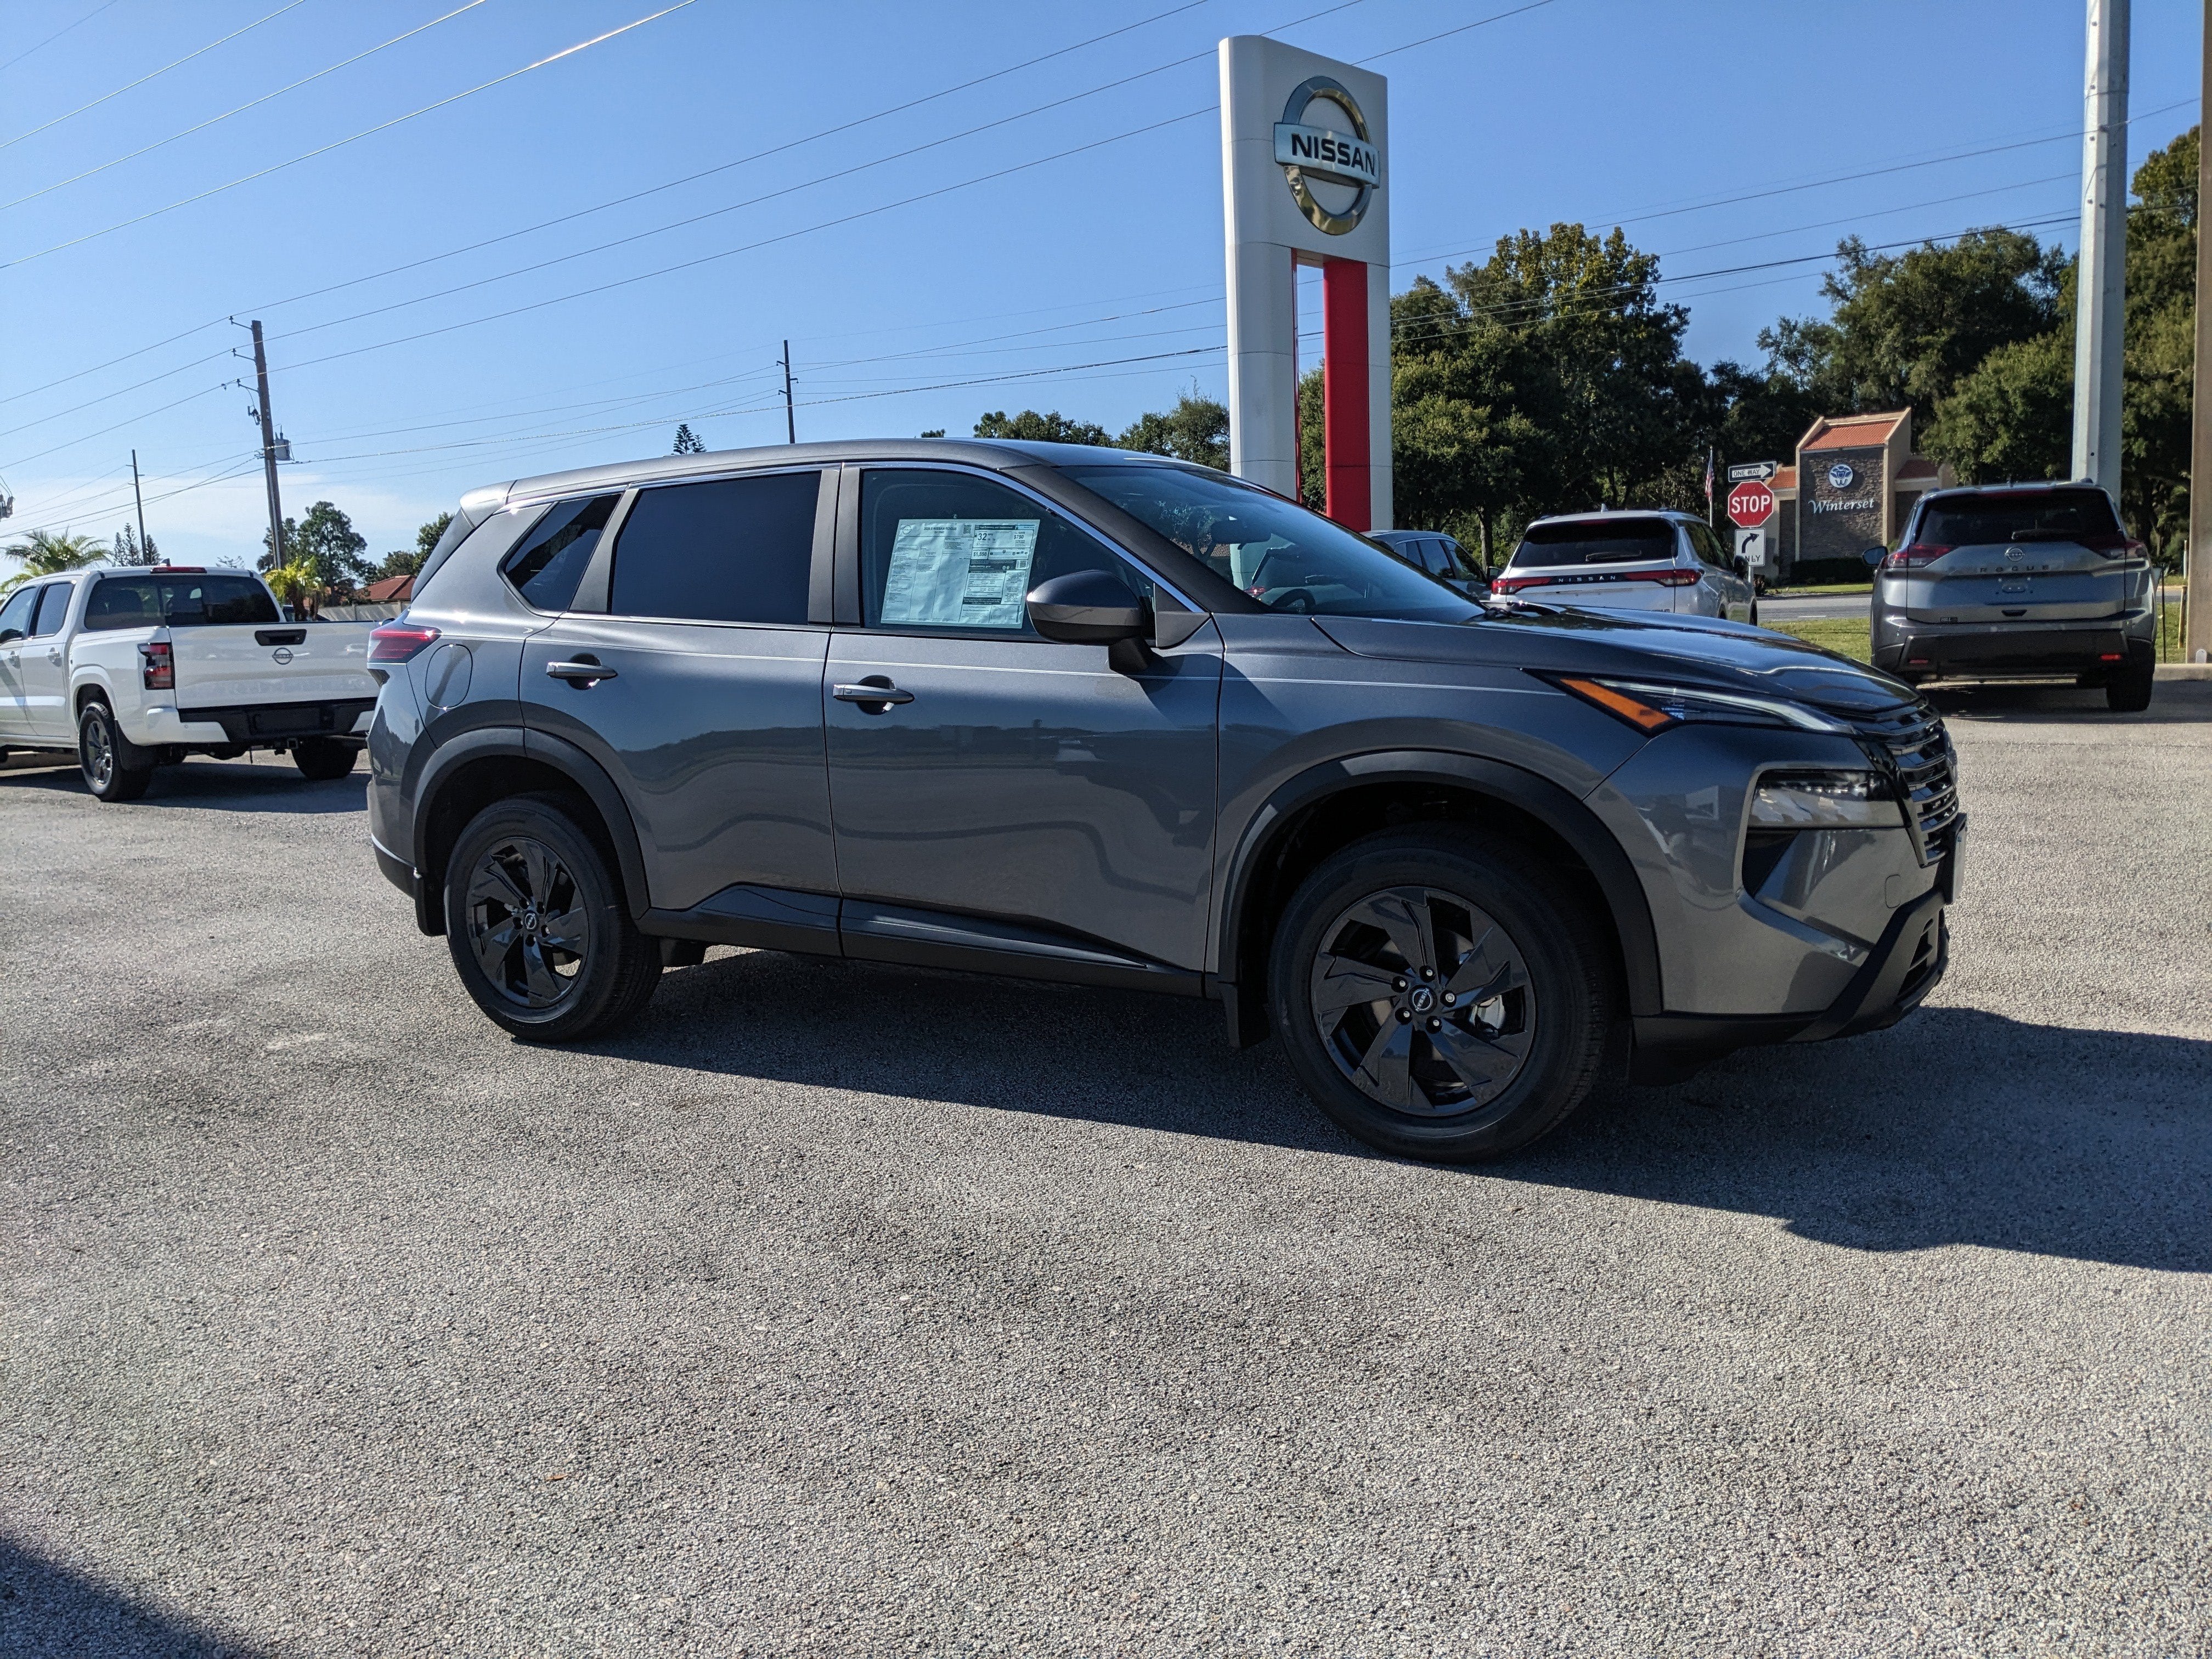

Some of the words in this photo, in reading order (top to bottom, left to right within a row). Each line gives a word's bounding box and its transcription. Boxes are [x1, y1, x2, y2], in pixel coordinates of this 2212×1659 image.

[1291, 133, 1375, 177] NISSAN
[1731, 495, 1770, 514] STOP
[1808, 497, 1875, 514] Winterset
[978, 533, 988, 541] 32
[1415, 988, 1429, 1012] NISSAN
